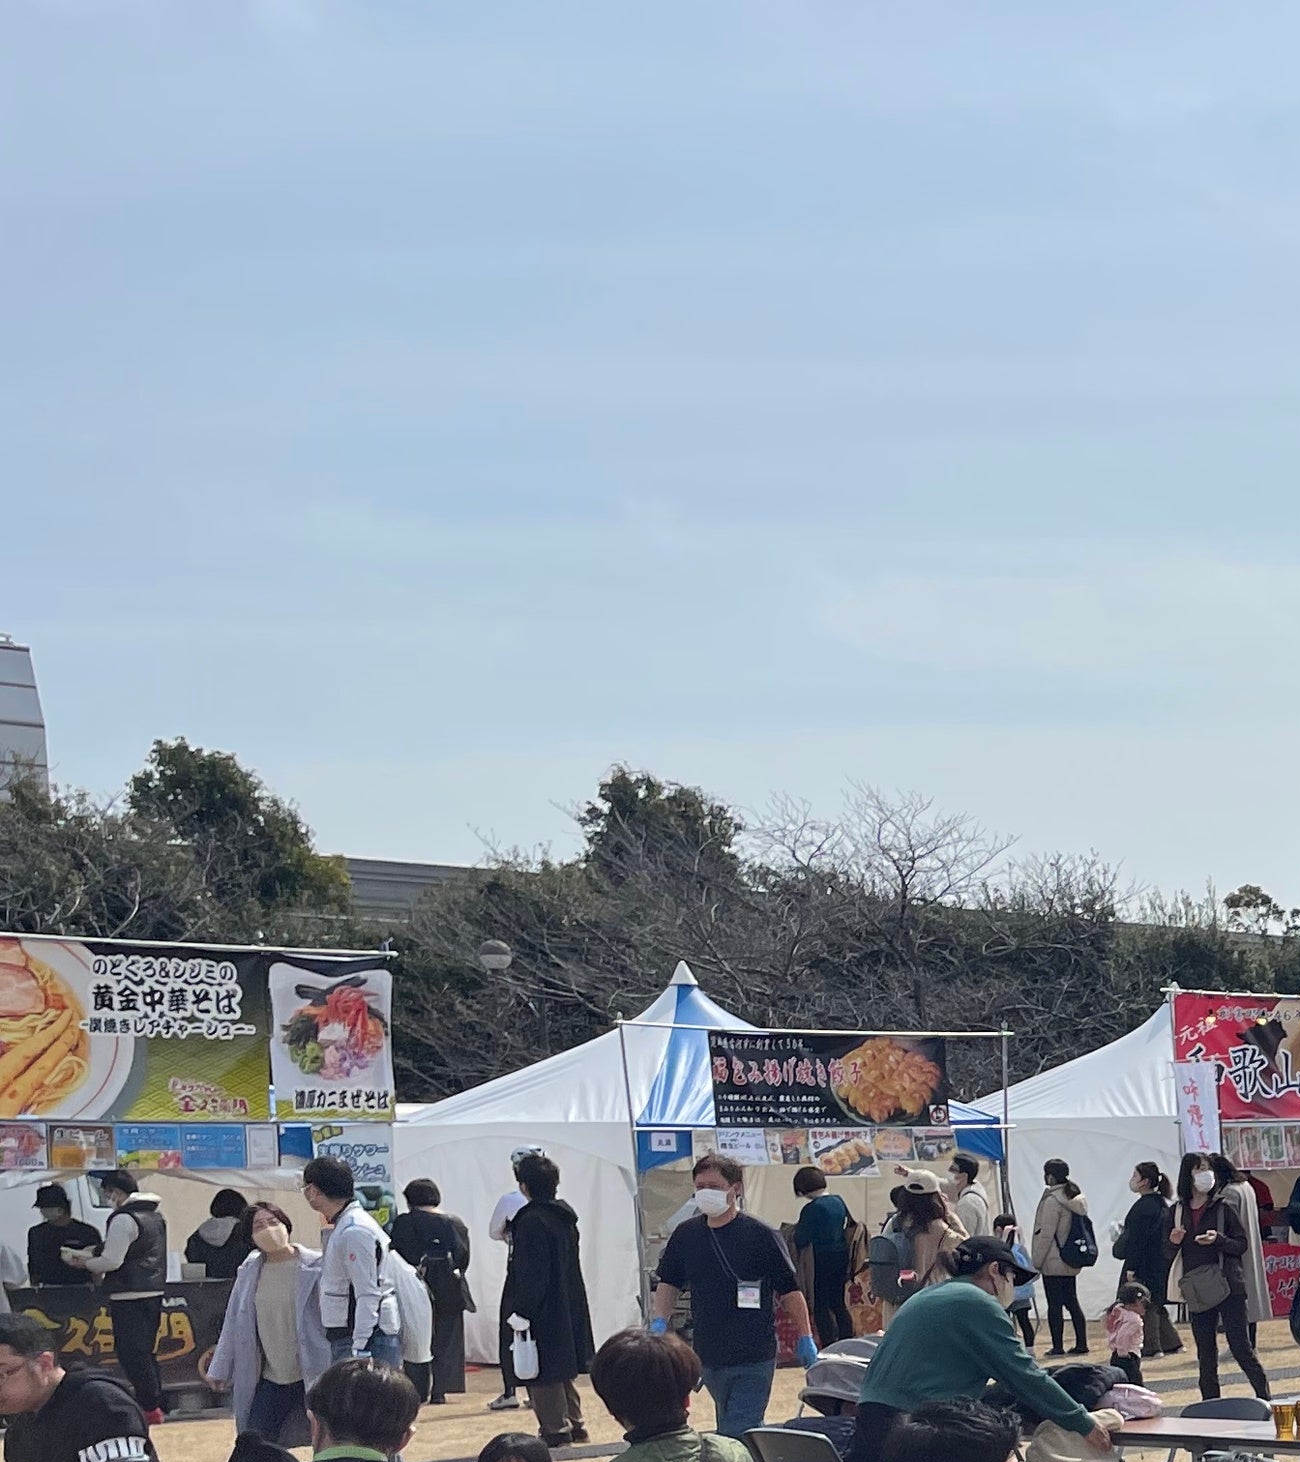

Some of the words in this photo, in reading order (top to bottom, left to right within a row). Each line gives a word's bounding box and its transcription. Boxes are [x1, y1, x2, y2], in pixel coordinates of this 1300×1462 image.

[92, 983, 238, 1015] 黄金中華そば
